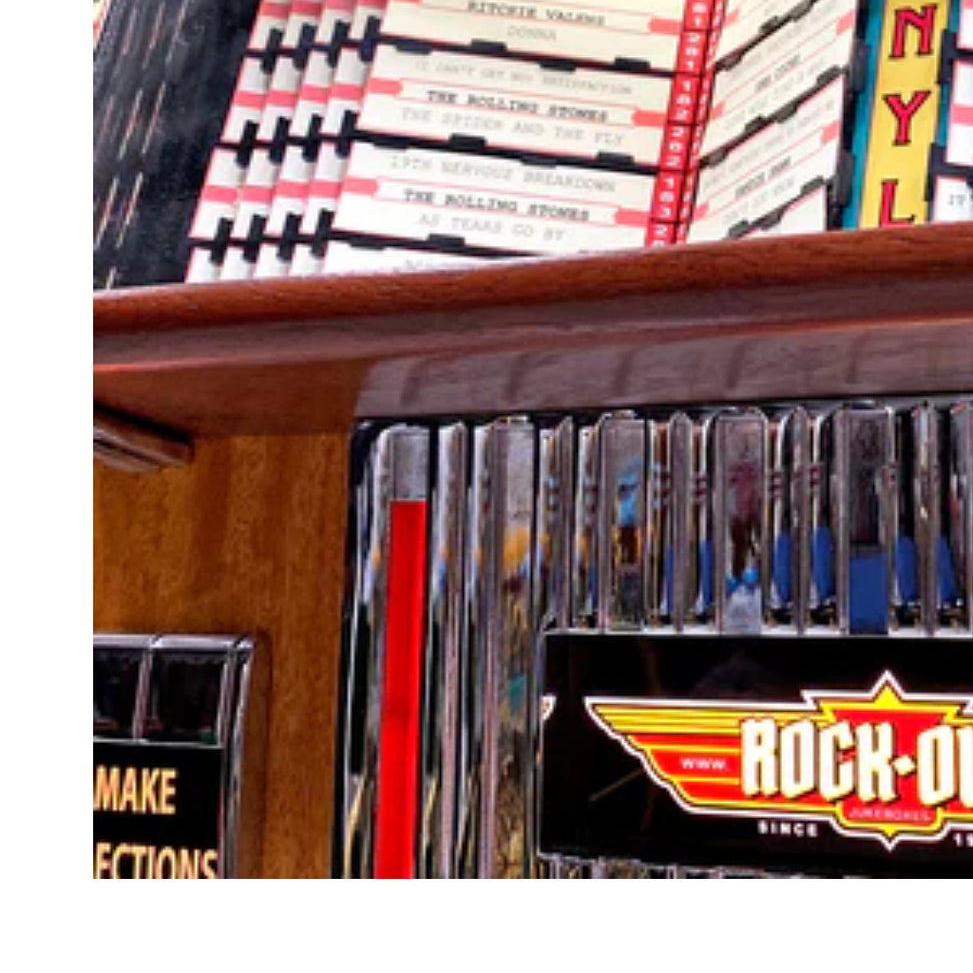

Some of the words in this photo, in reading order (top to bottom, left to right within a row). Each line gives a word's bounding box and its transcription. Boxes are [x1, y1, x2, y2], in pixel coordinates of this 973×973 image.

[546, 8, 606, 27] VALENS
[506, 24, 558, 42] DONNA
[425, 89, 457, 105] THE
[467, 93, 538, 115] ROLLING
[548, 105, 609, 123] STONES
[401, 107, 432, 124] THE
[514, 120, 545, 137] AND
[554, 123, 585, 140] THE
[522, 167, 616, 193] BREAKDOWN
[403, 187, 435, 204] THE
[444, 192, 518, 214] ROLLING
[525, 203, 591, 222] STONES
[418, 212, 441, 227] AS
[452, 216, 503, 235] TEARS
[512, 223, 536, 239] GO
[542, 225, 567, 242] BY
[679, 756, 729, 772] www.
[93, 764, 177, 815] MAKE
[757, 819, 819, 838] SINCE
[95, 841, 219, 879] ECTIONS
